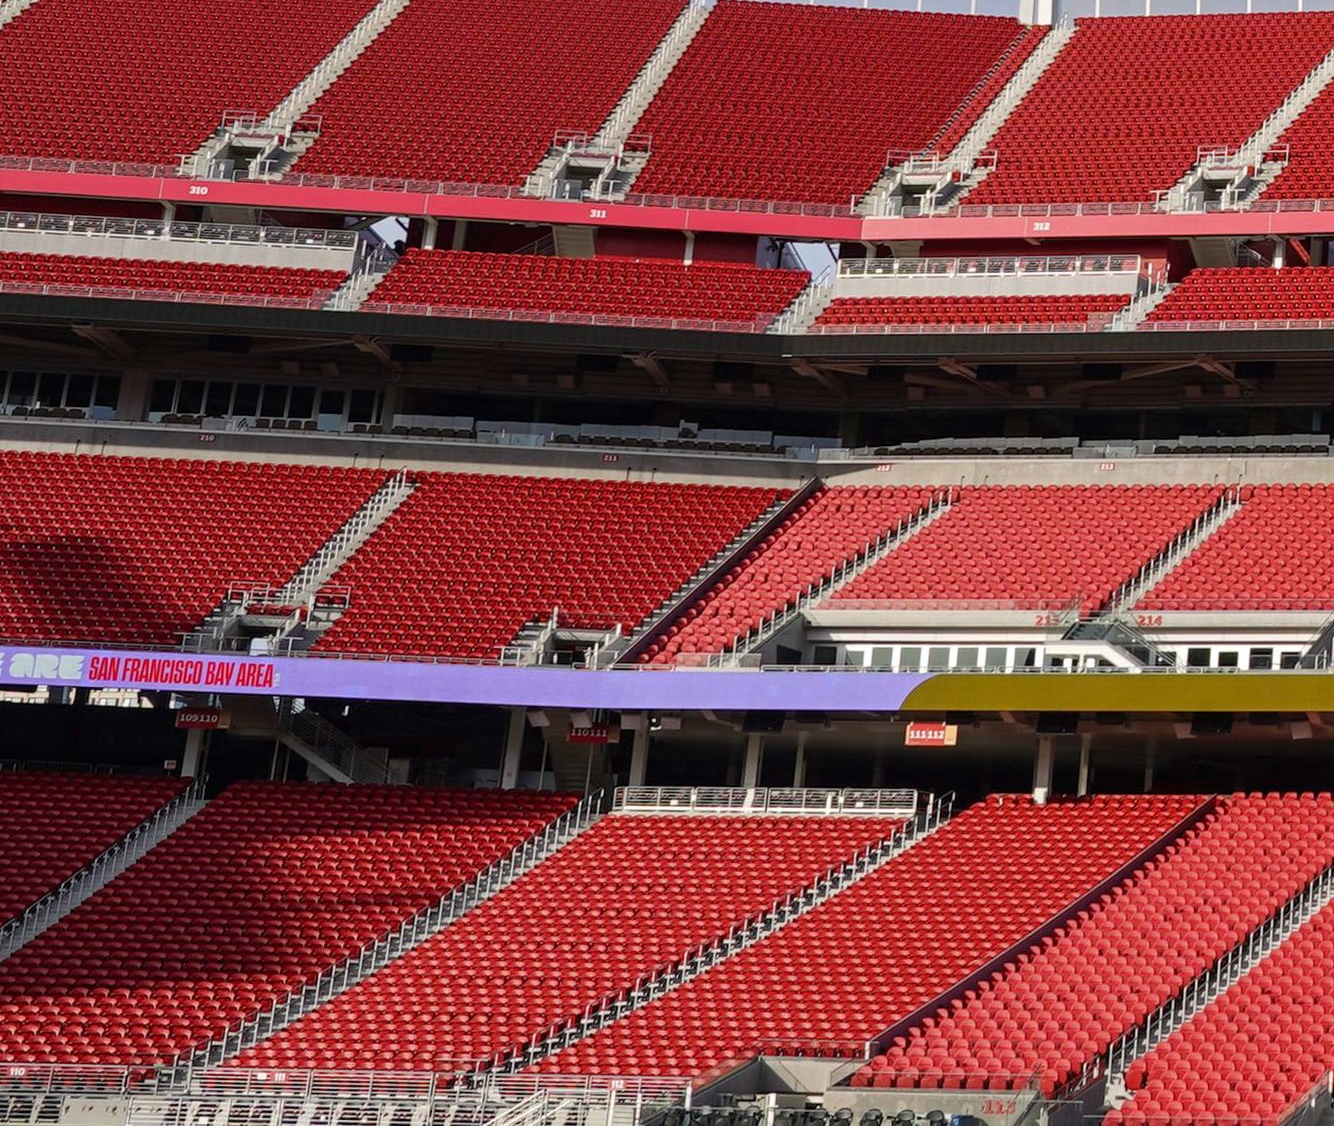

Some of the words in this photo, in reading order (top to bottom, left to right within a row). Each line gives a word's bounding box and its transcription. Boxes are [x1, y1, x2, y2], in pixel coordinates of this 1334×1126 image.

[190, 185, 208, 195] 310
[590, 209, 607, 218] 311
[1137, 615, 1163, 626] 214
[89, 657, 120, 681] SAN
[122, 658, 203, 685] FRANCISCO
[205, 661, 234, 686] BAY
[235, 663, 275, 688] AREA
